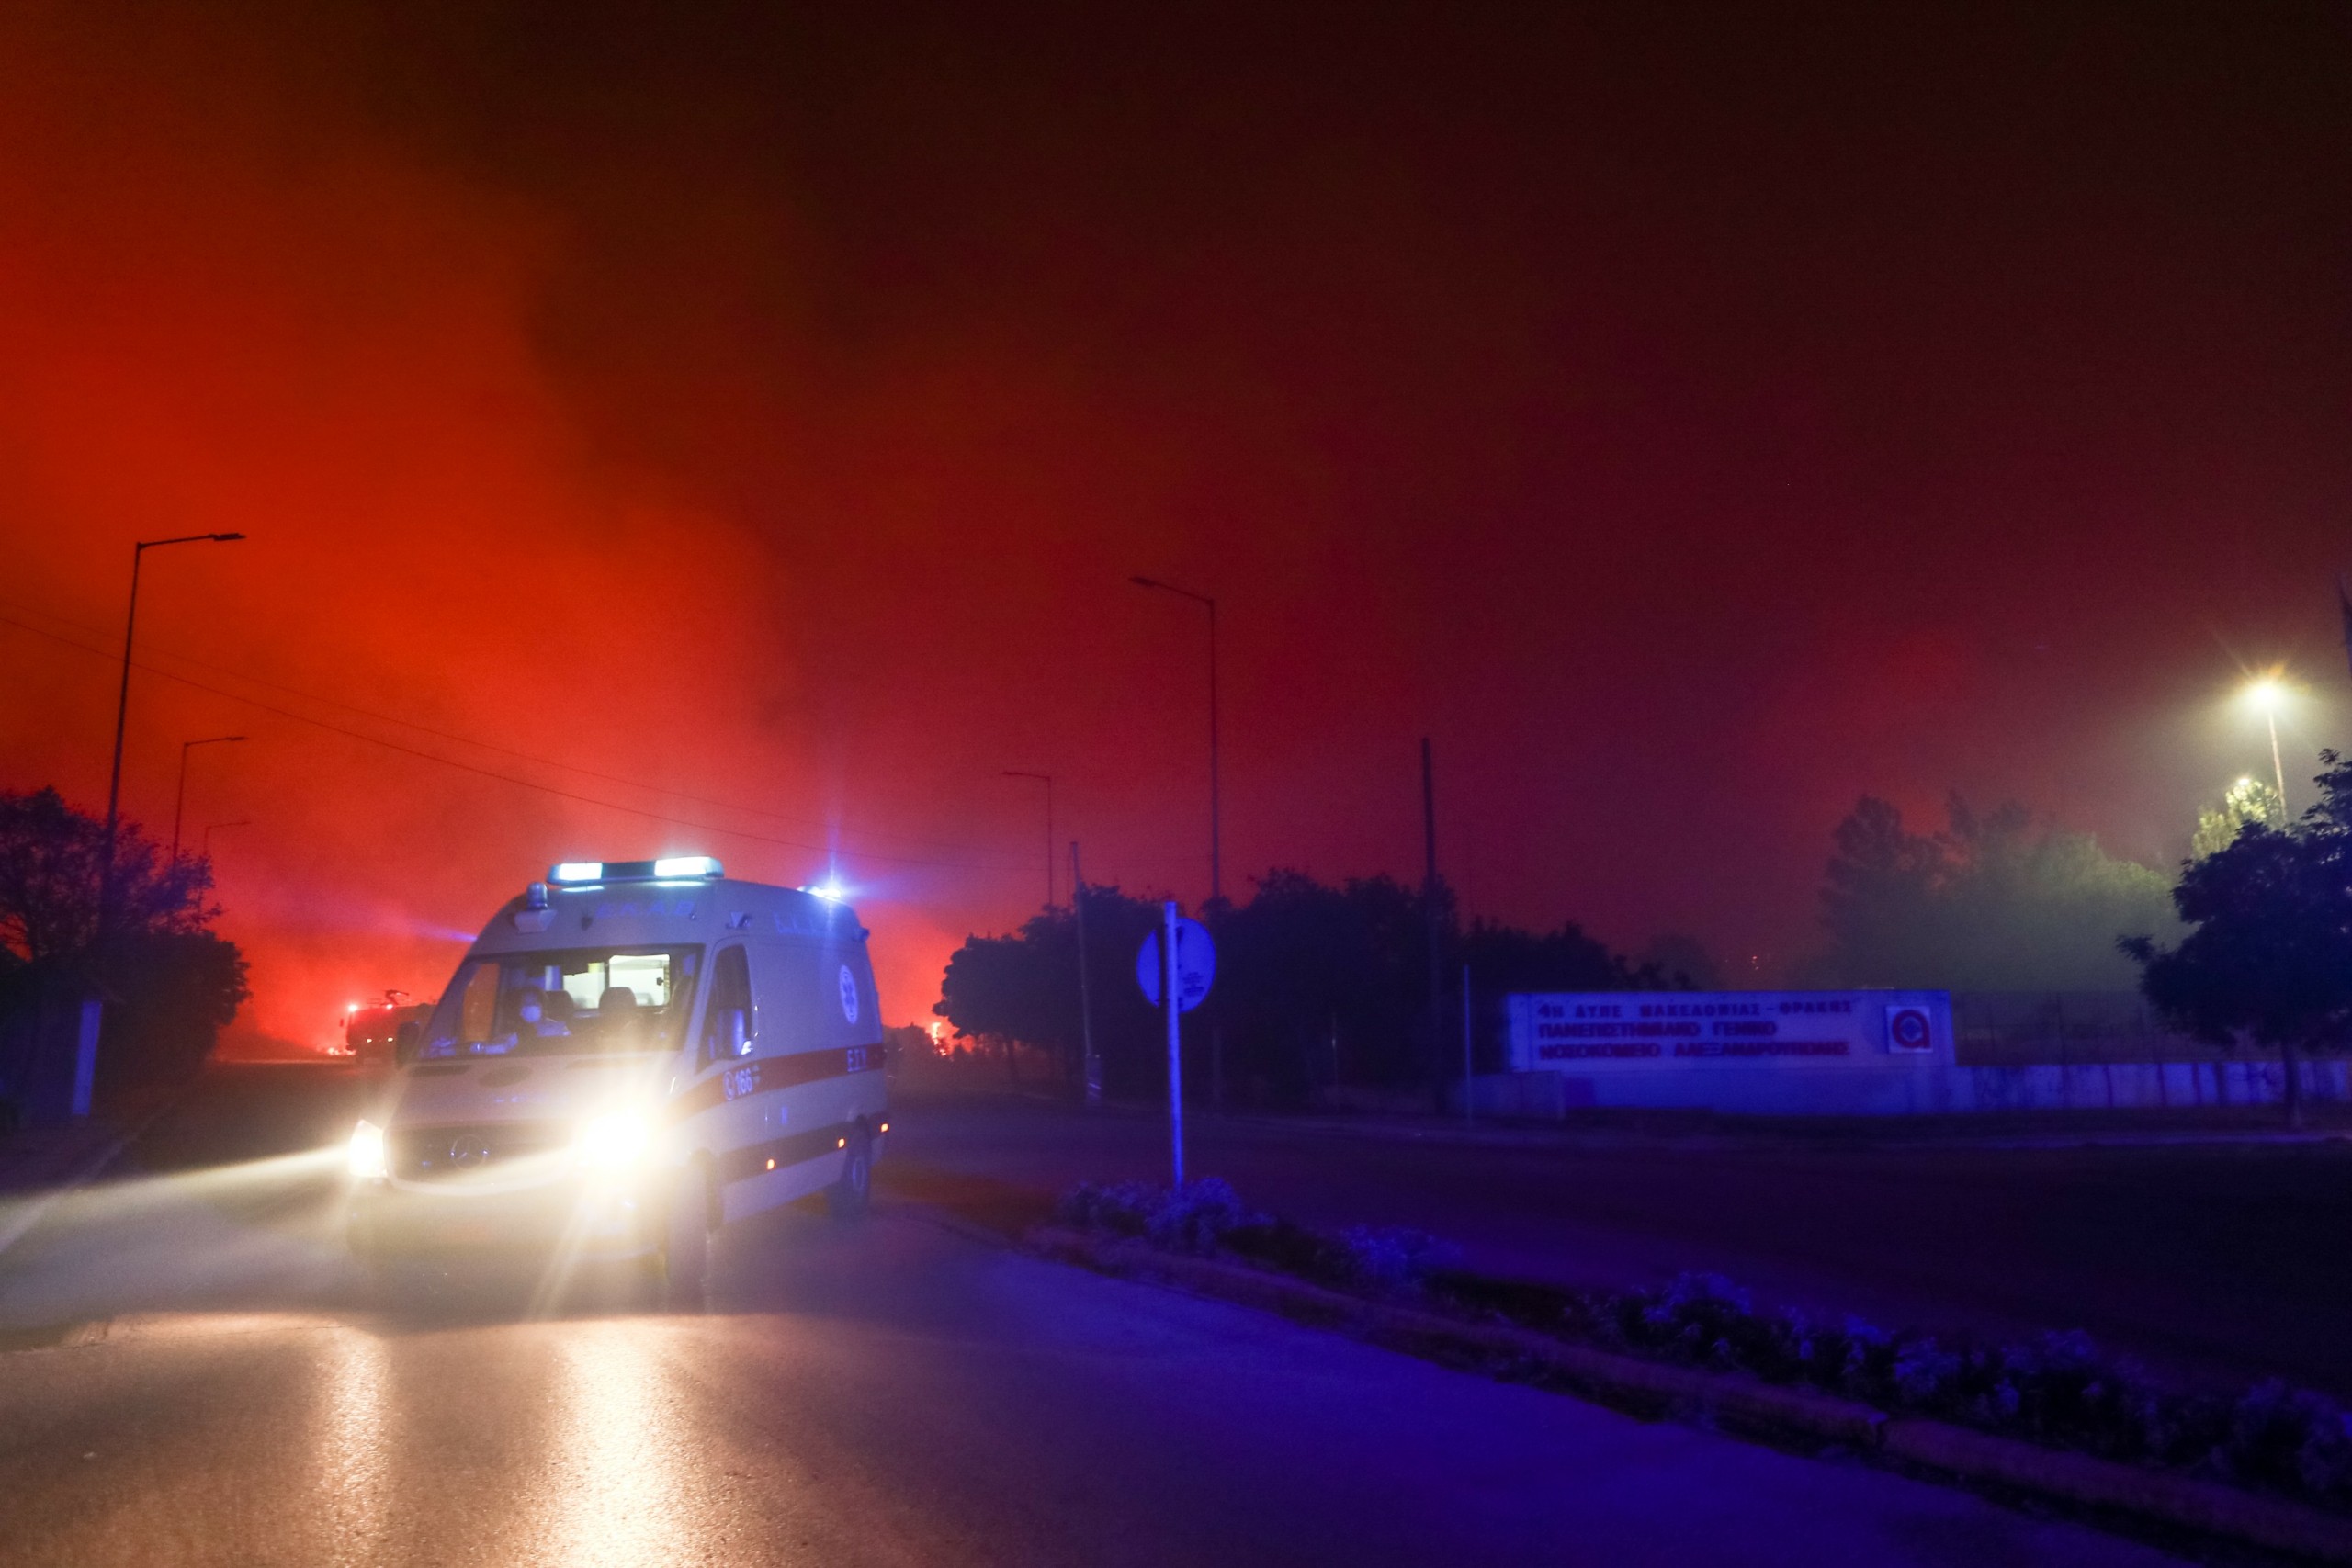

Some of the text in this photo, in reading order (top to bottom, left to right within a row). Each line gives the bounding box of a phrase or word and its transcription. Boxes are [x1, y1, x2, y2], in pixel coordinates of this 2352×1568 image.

[1713, 1021, 1779, 1038] ΓΕΝΙΚΟ
[1539, 1043, 1662, 1060] ΝΟΣΟΚΟΜΕΙΟ
[735, 1067, 753, 1096] 166
